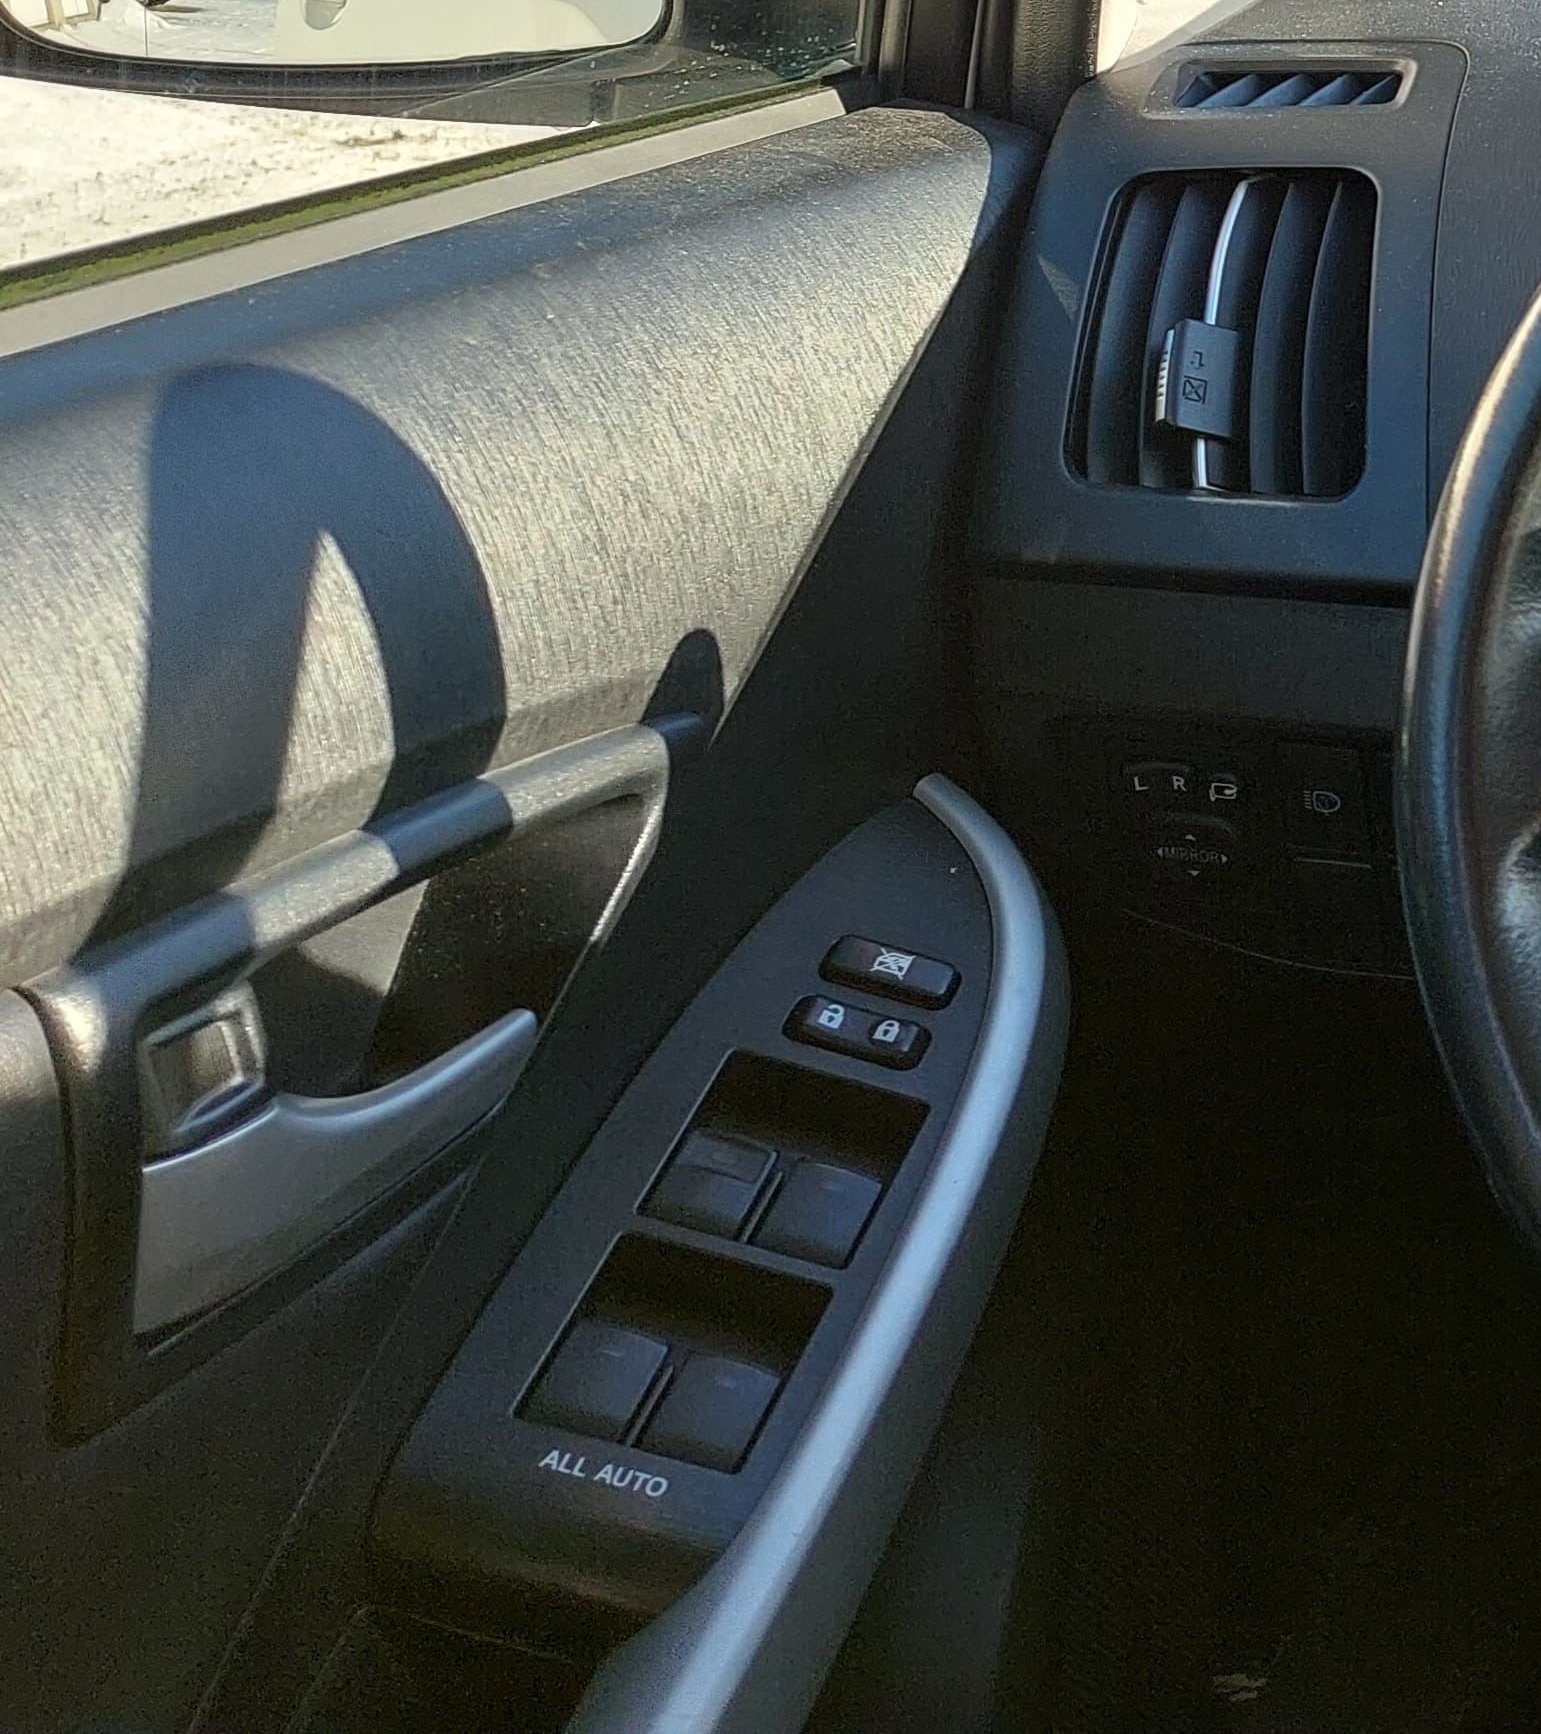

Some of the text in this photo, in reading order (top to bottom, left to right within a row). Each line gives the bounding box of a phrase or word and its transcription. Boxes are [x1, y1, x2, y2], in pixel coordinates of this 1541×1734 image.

[1172, 775, 1187, 791] R
[538, 1448, 668, 1498] ALL AUTO
